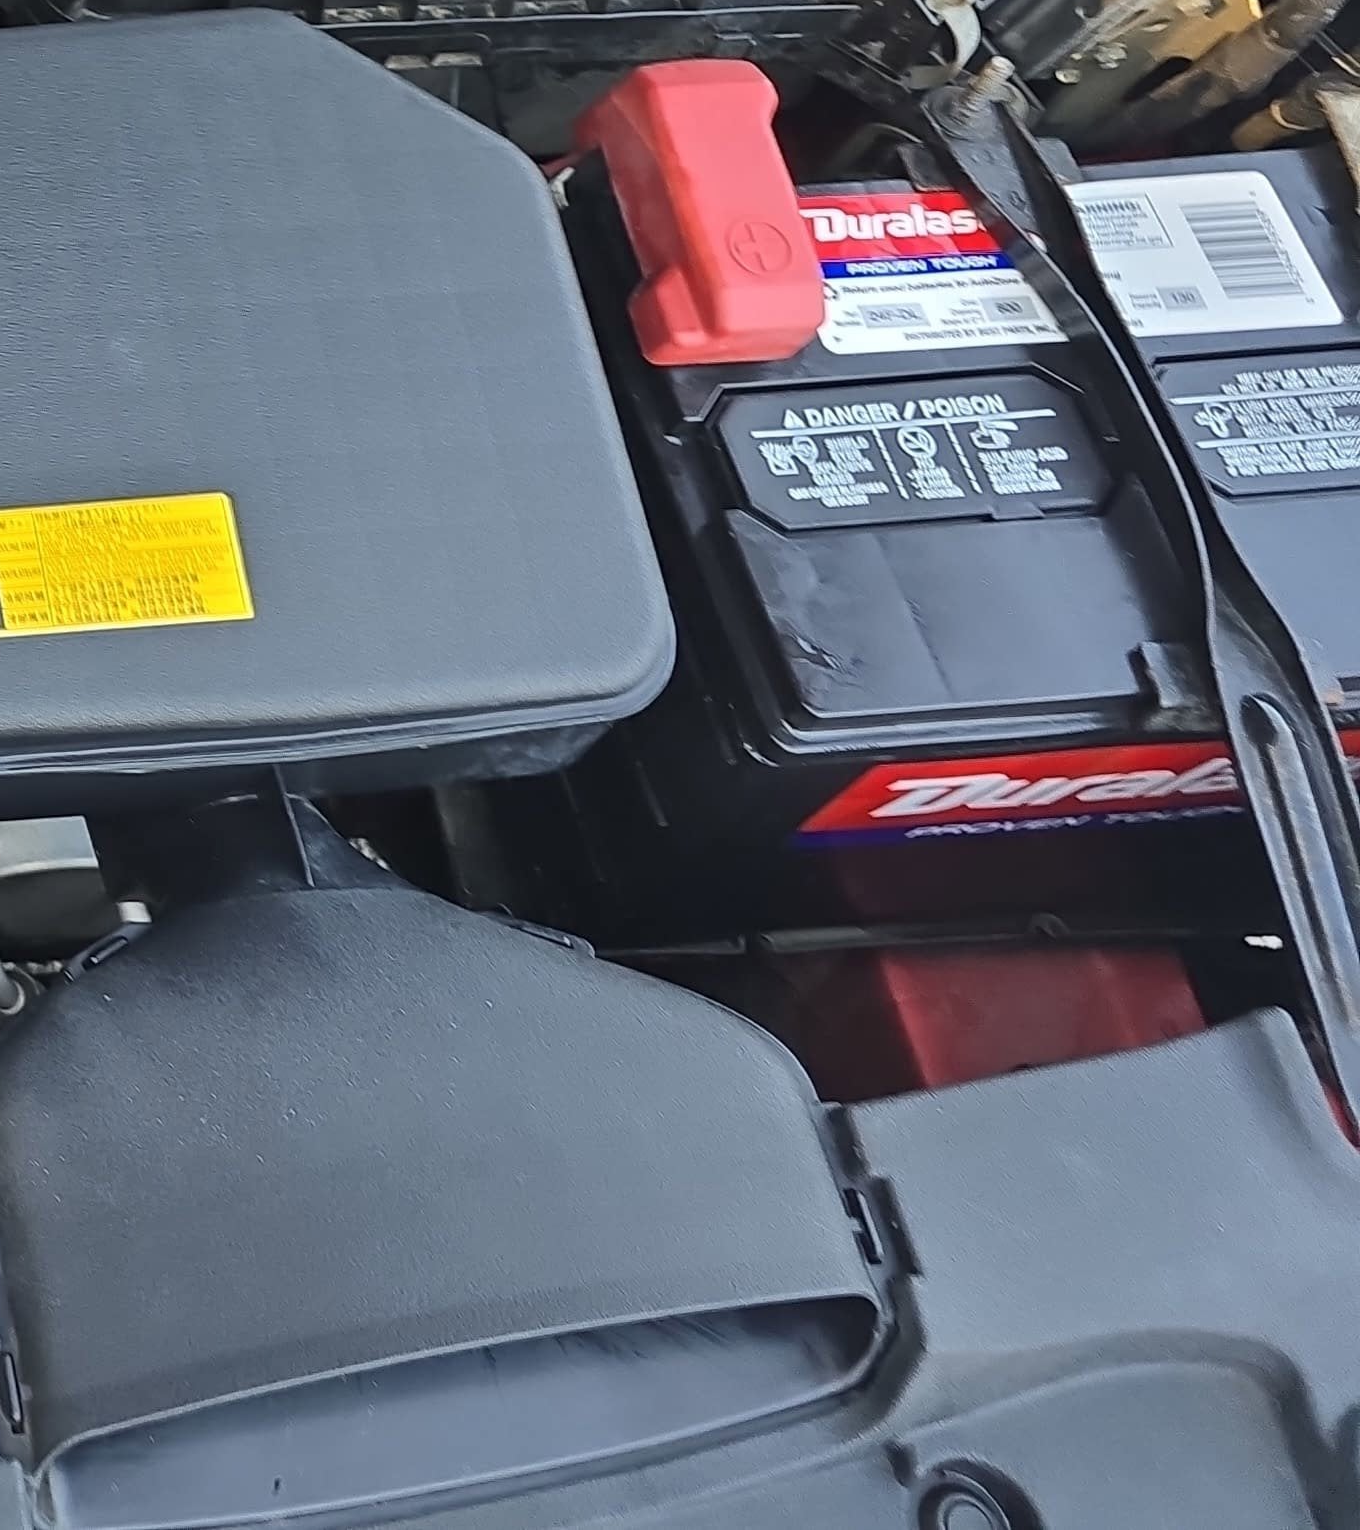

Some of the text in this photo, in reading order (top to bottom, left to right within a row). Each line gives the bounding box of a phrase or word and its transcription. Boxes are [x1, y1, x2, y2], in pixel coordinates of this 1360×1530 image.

[1077, 200, 1143, 216] ARNING:
[799, 204, 987, 242] Duralas
[845, 254, 1000, 276] PROVEN TOUGH
[804, 403, 901, 427] DANGER
[919, 394, 1007, 418] POISON
